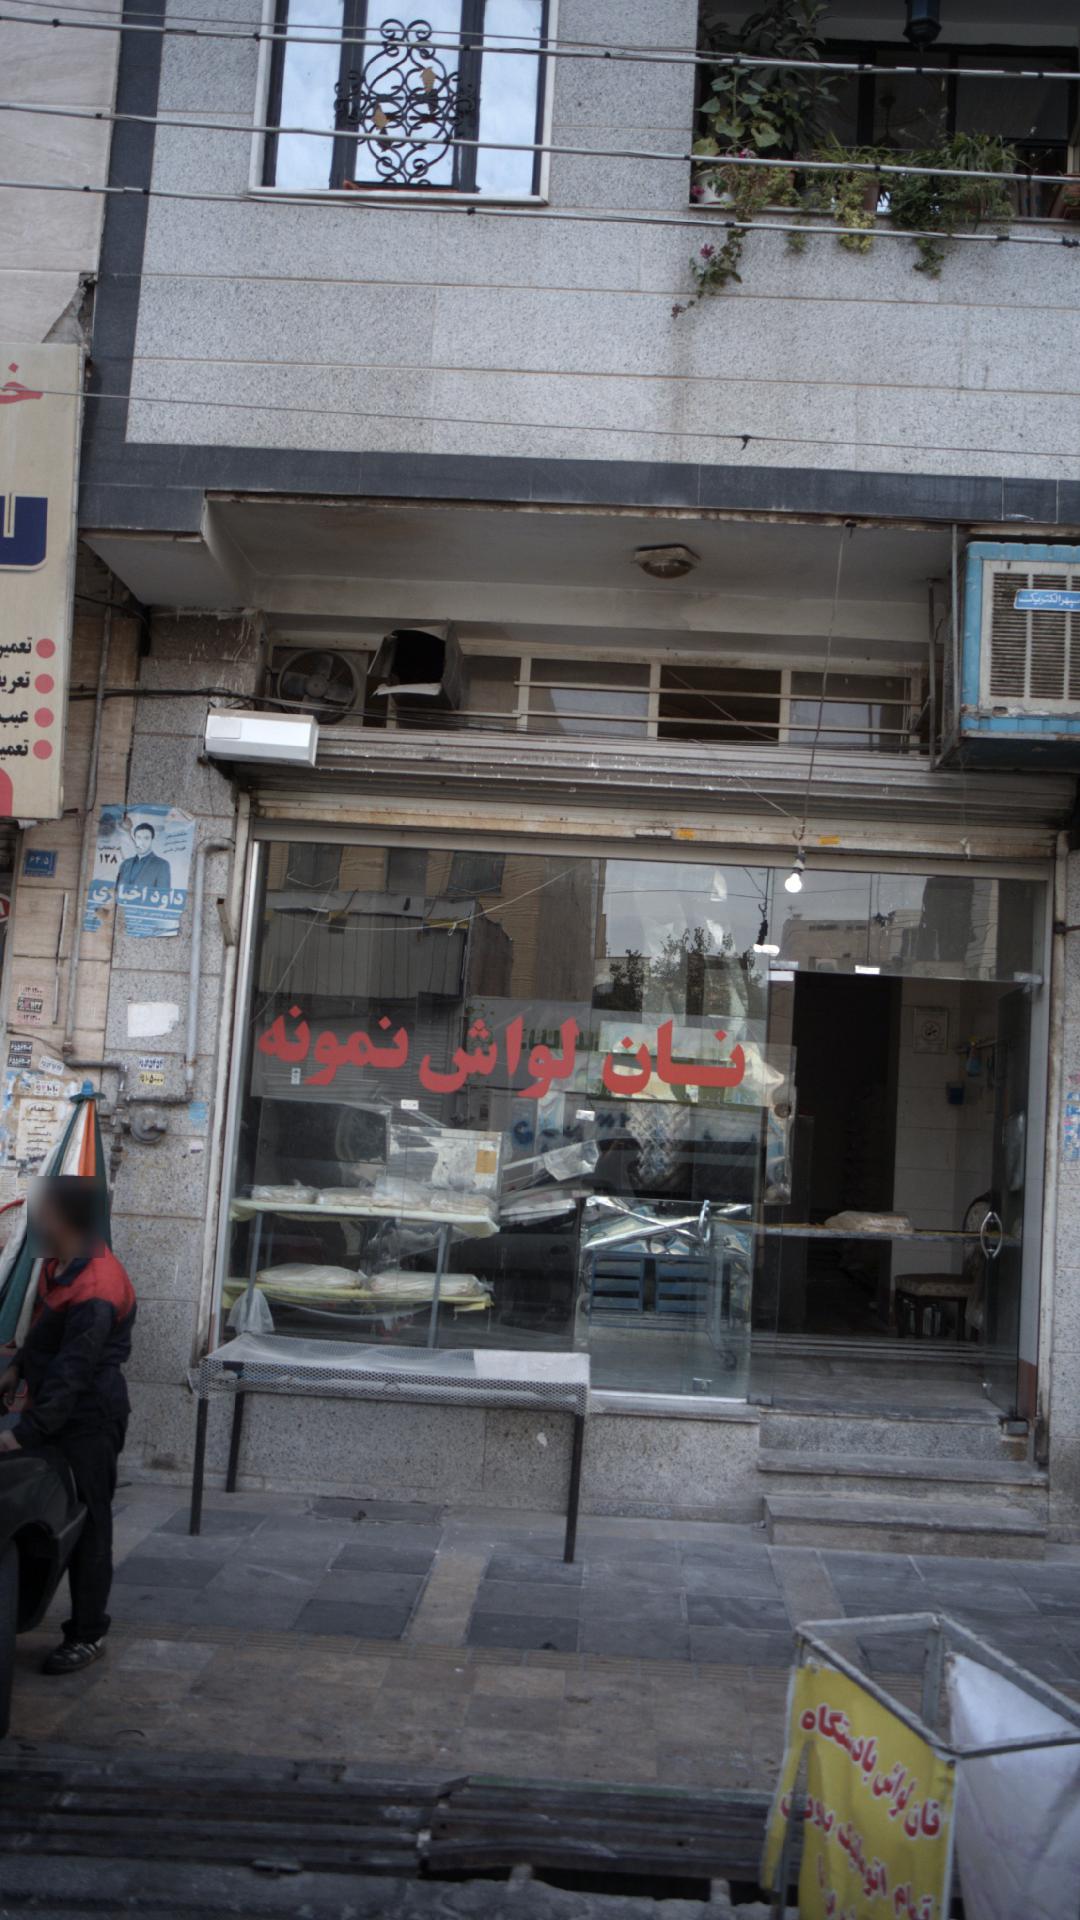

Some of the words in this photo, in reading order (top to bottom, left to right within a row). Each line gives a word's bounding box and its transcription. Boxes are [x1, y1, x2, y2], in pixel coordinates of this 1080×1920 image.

[150, 887, 184, 910] داود
[258, 1005, 409, 1085] نمونه
[419, 1016, 579, 1098] لواش
[603, 1020, 745, 1094] نان
